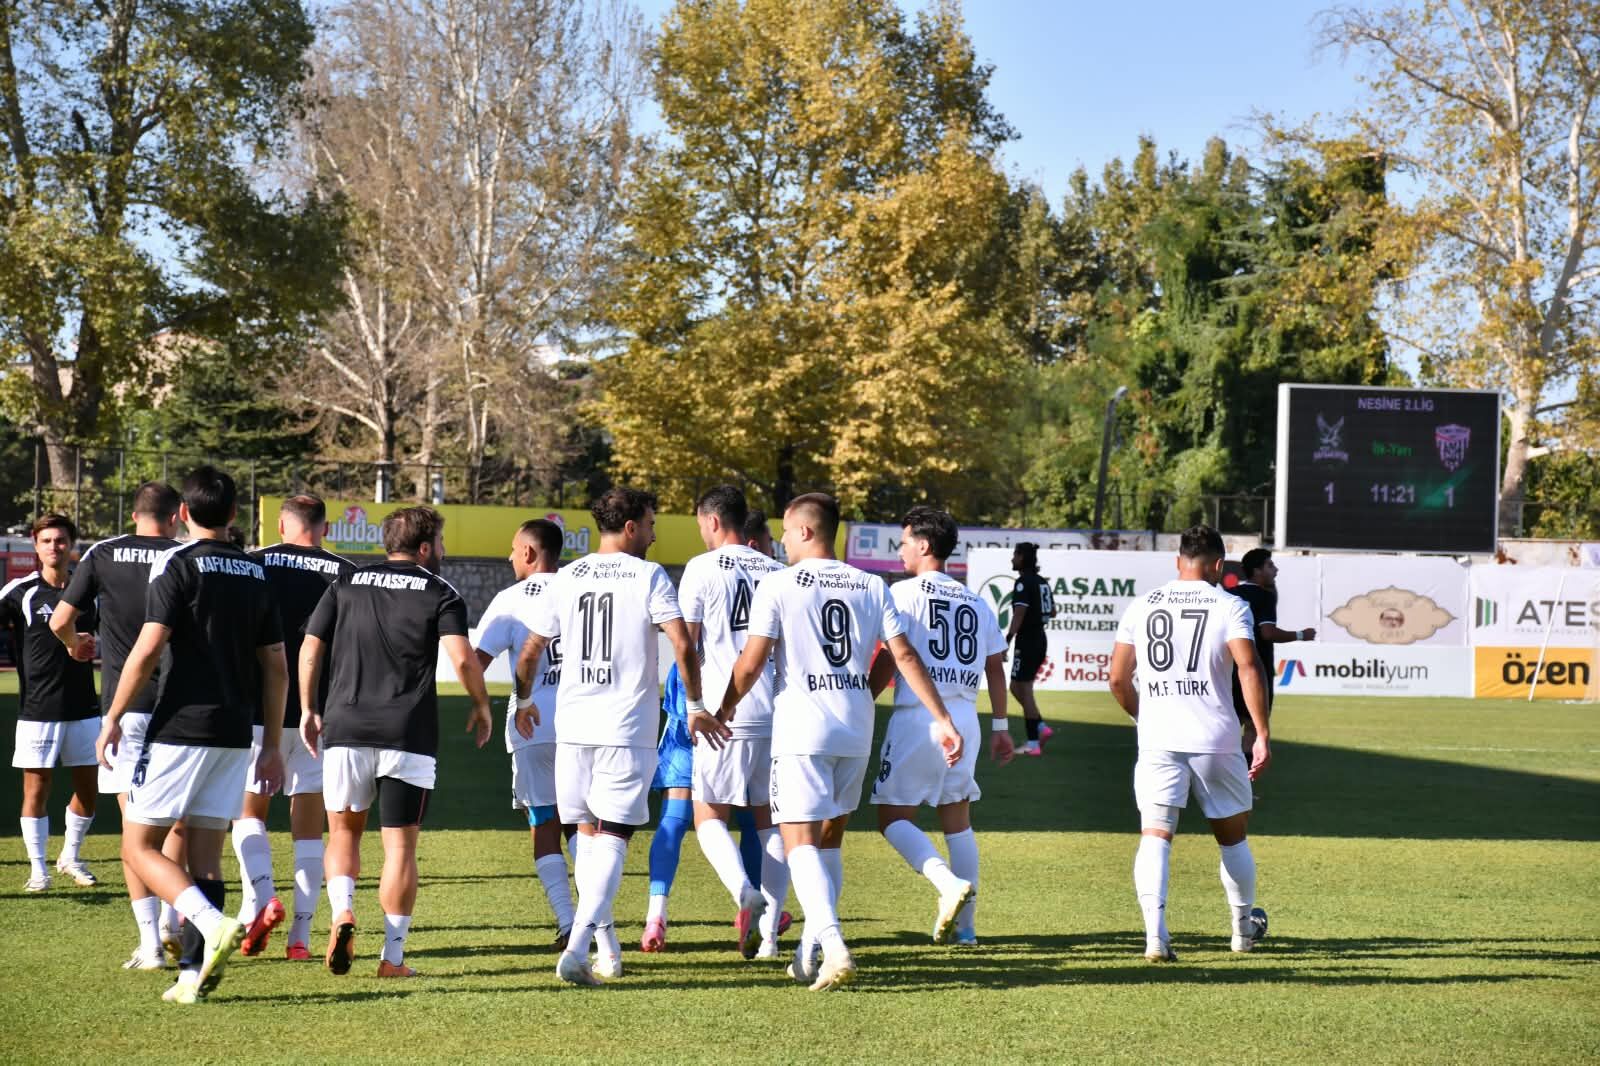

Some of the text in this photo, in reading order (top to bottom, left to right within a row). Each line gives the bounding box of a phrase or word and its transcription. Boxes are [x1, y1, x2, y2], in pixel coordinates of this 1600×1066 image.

[1358, 396, 1401, 410] NESİNE
[1324, 482, 1335, 504] 1
[1370, 484, 1415, 503] 11:21
[1445, 487, 1455, 508] 1
[113, 547, 160, 563] KAFKA
[264, 552, 340, 575] KAFKASSPOR
[195, 556, 265, 581] KAFKASSPOR
[818, 571, 850, 581] İnegöl
[351, 571, 428, 591] KAFKASSPOR
[819, 579, 868, 591] Mobilyası
[1043, 576, 1137, 600] AŞAM
[1167, 597, 1217, 605] Mobilyası
[579, 591, 613, 661] 11
[821, 598, 852, 668] 9
[928, 598, 979, 665] 58
[1043, 616, 1118, 631] RÜNLER
[1146, 608, 1209, 673] 87
[1064, 646, 1113, 668] İneg
[581, 664, 612, 684] İNCİ
[928, 666, 957, 684] AHYA
[1315, 658, 1428, 684] mobiliyum
[1502, 652, 1590, 685] özen
[1148, 677, 1209, 697] M.F. TÜRK
